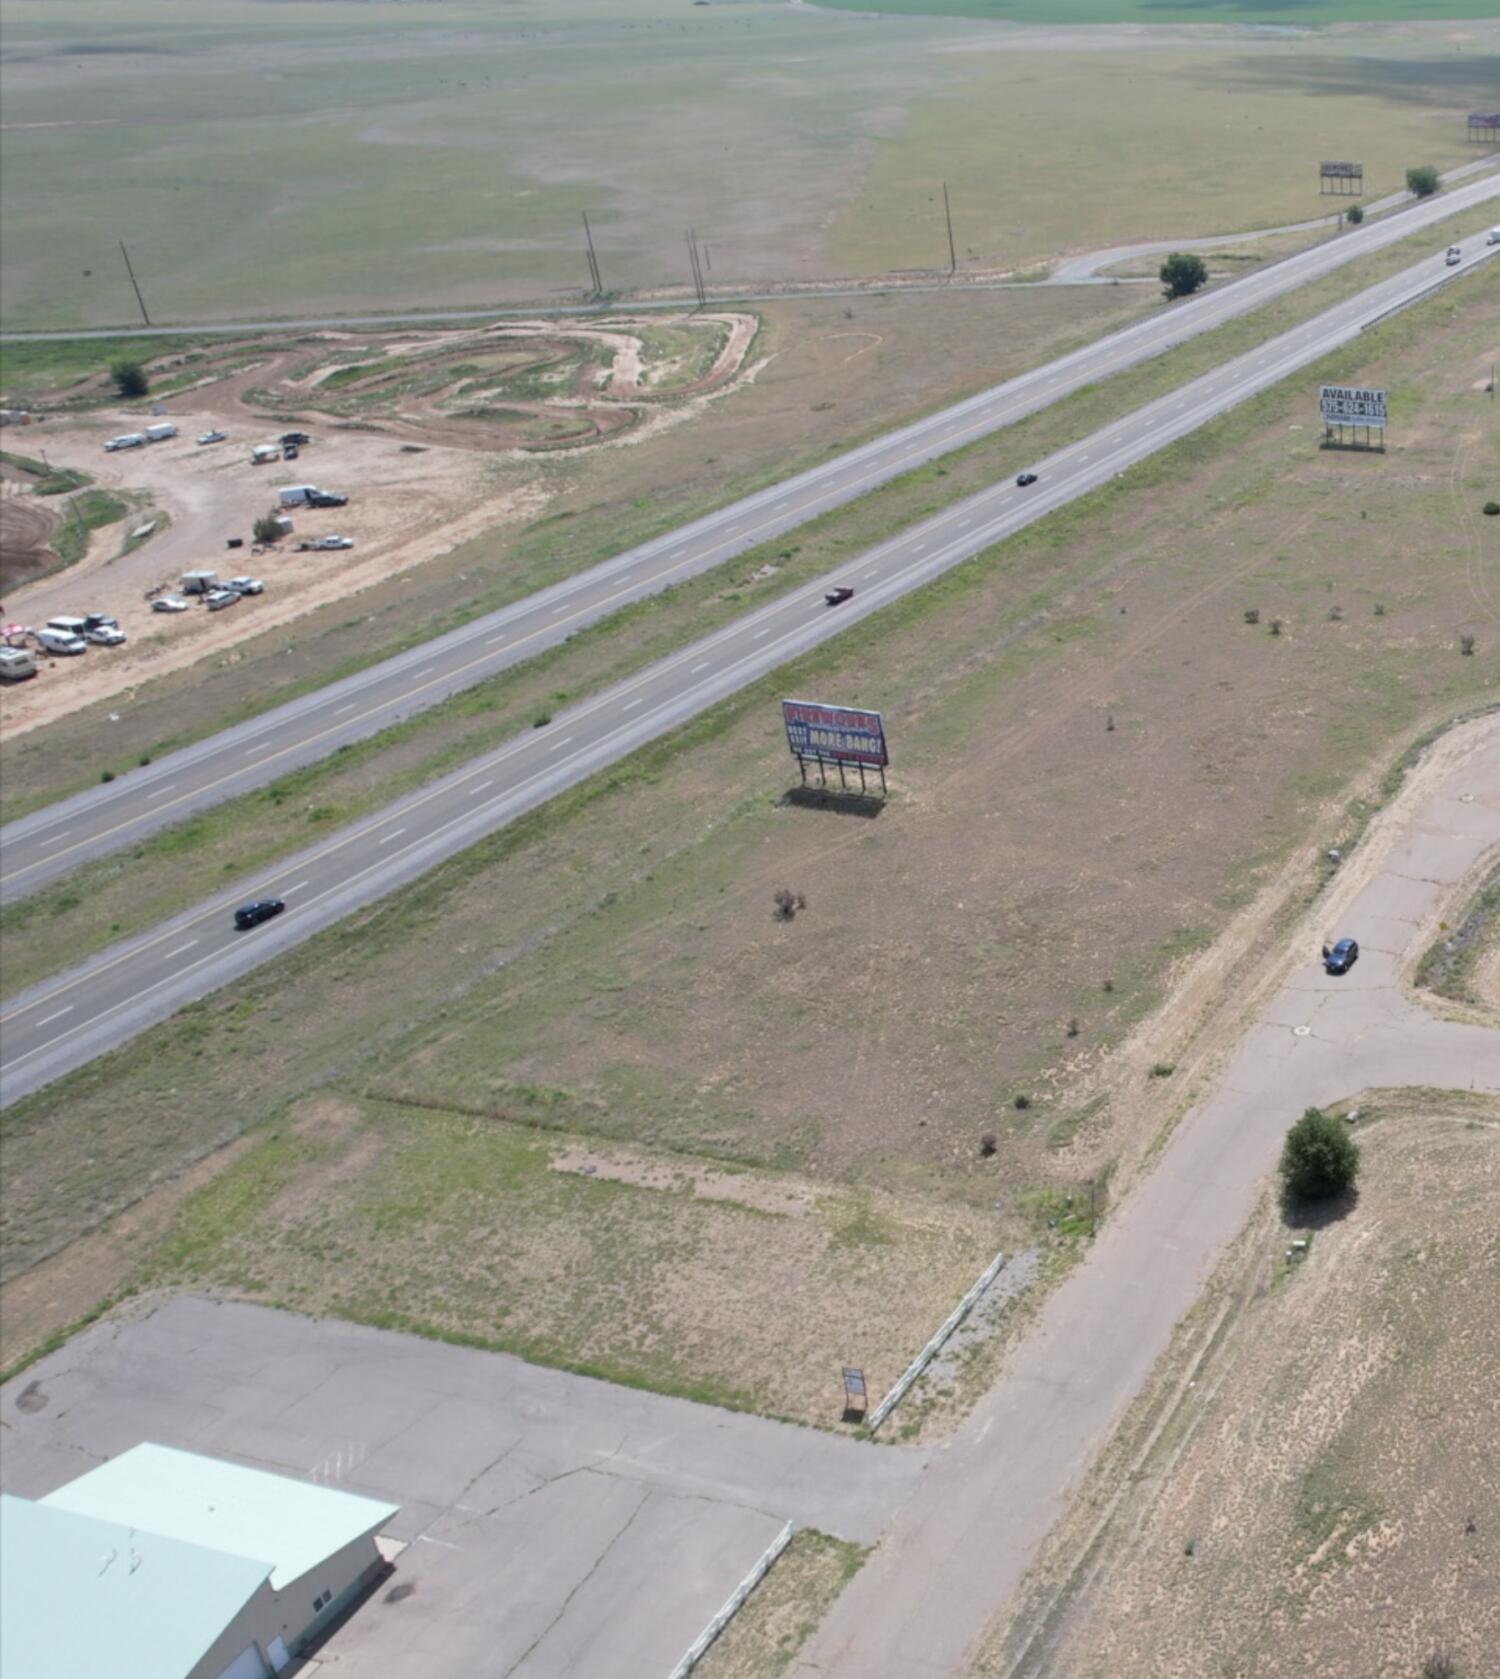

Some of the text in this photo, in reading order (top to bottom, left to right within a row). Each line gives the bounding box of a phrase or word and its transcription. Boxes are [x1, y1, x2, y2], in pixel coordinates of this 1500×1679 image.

[1323, 388, 1384, 402] AVAILABLE
[810, 730, 881, 753] MORE BANG!
